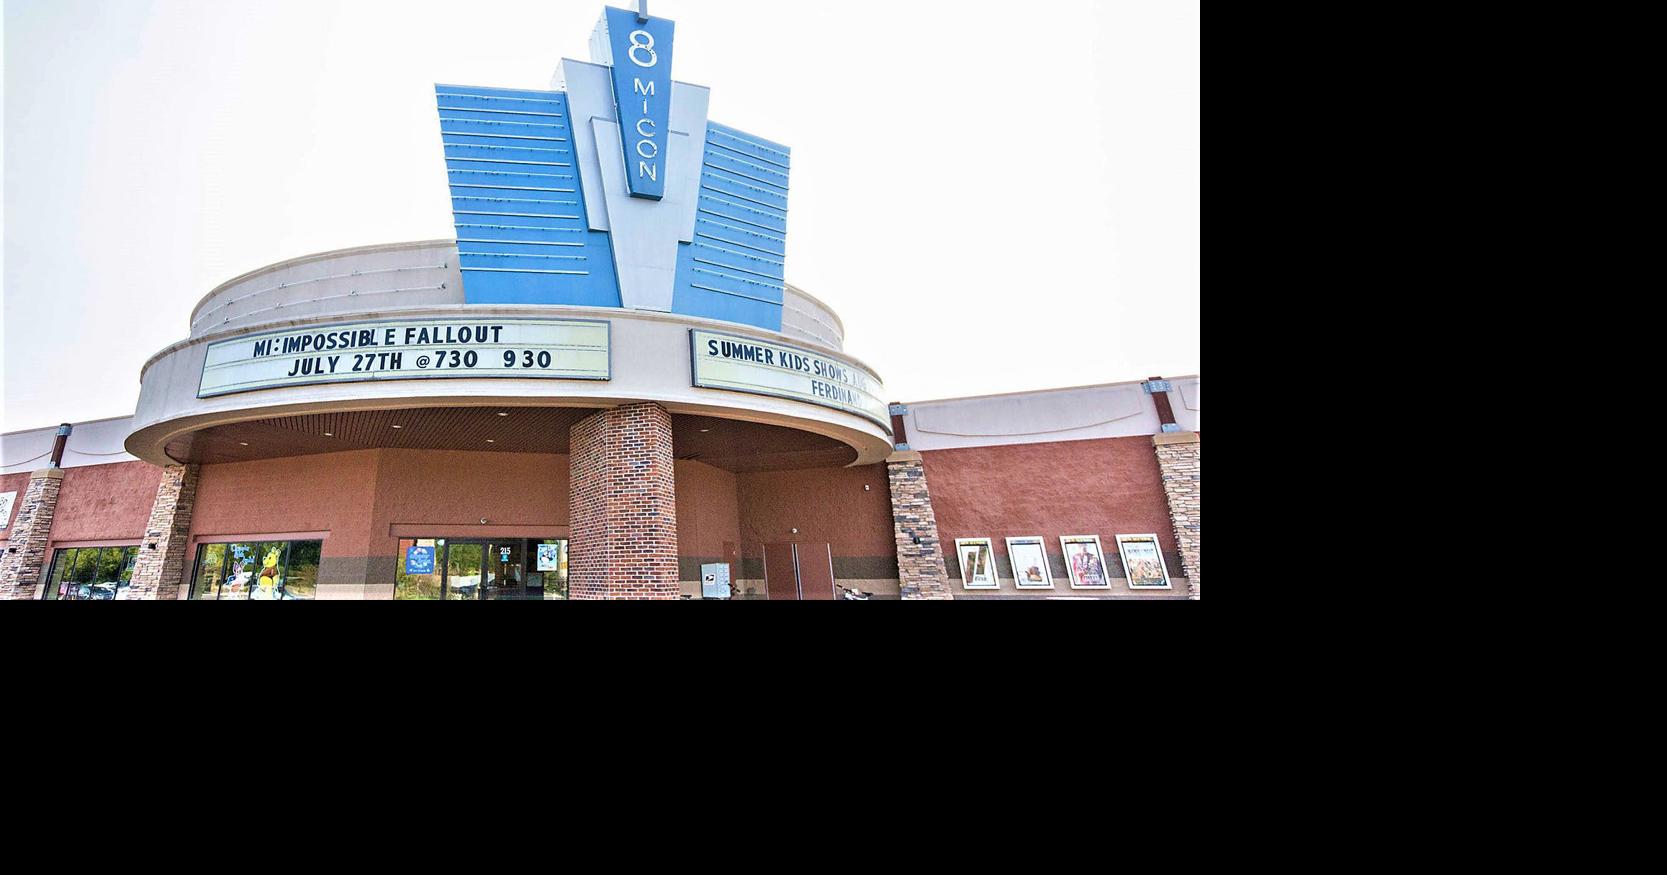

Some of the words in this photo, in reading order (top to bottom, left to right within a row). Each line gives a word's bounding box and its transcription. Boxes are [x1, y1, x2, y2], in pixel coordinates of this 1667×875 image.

[628, 29, 658, 68] 8
[633, 77, 658, 182] MICON
[404, 325, 503, 345] FALLOUT
[288, 355, 340, 377] JULY
[352, 351, 403, 372] 27TH
[503, 349, 552, 369] 930
[708, 339, 774, 365] SUMMER
[779, 351, 810, 373] KIDS
[814, 359, 849, 383] SHOWS
[500, 546, 511, 555] 215
